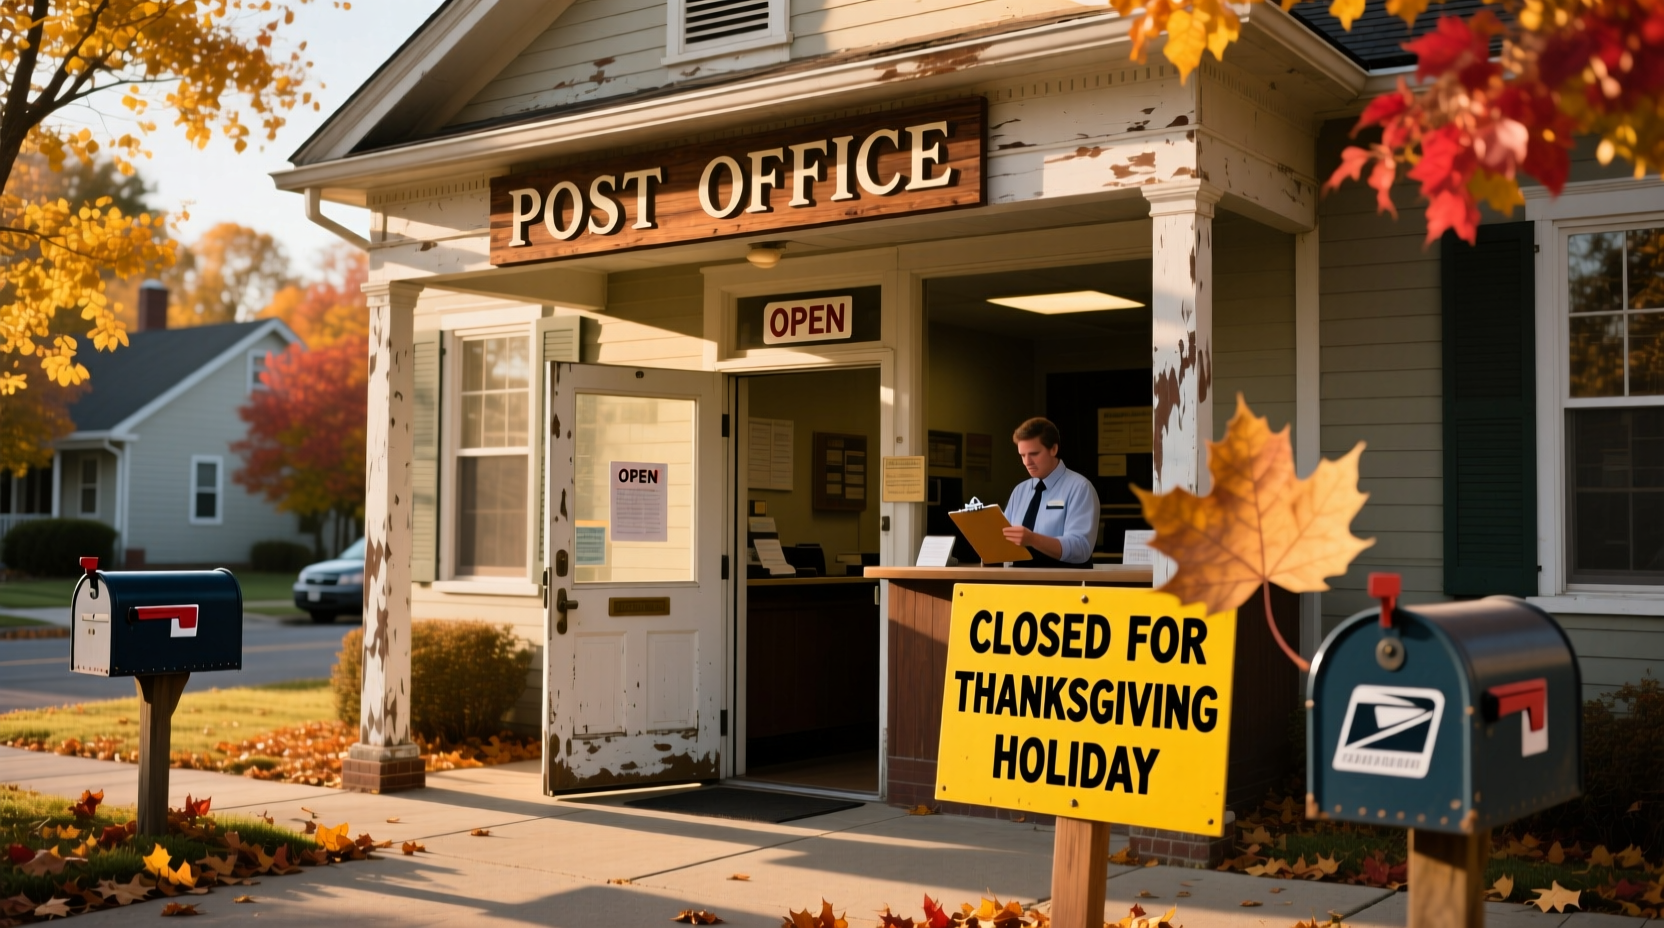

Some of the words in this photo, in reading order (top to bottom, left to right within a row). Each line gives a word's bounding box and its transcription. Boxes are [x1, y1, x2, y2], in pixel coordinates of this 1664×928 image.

[508, 166, 662, 248] POST
[698, 120, 953, 220] OFFICE
[769, 302, 846, 338] OPEN
[618, 468, 659, 484] OPEN
[969, 609, 1112, 660] CLOSED
[1126, 615, 1208, 665] FOR
[954, 670, 1219, 733] THANKSGIVING
[992, 733, 1161, 796] HOLIDAY
